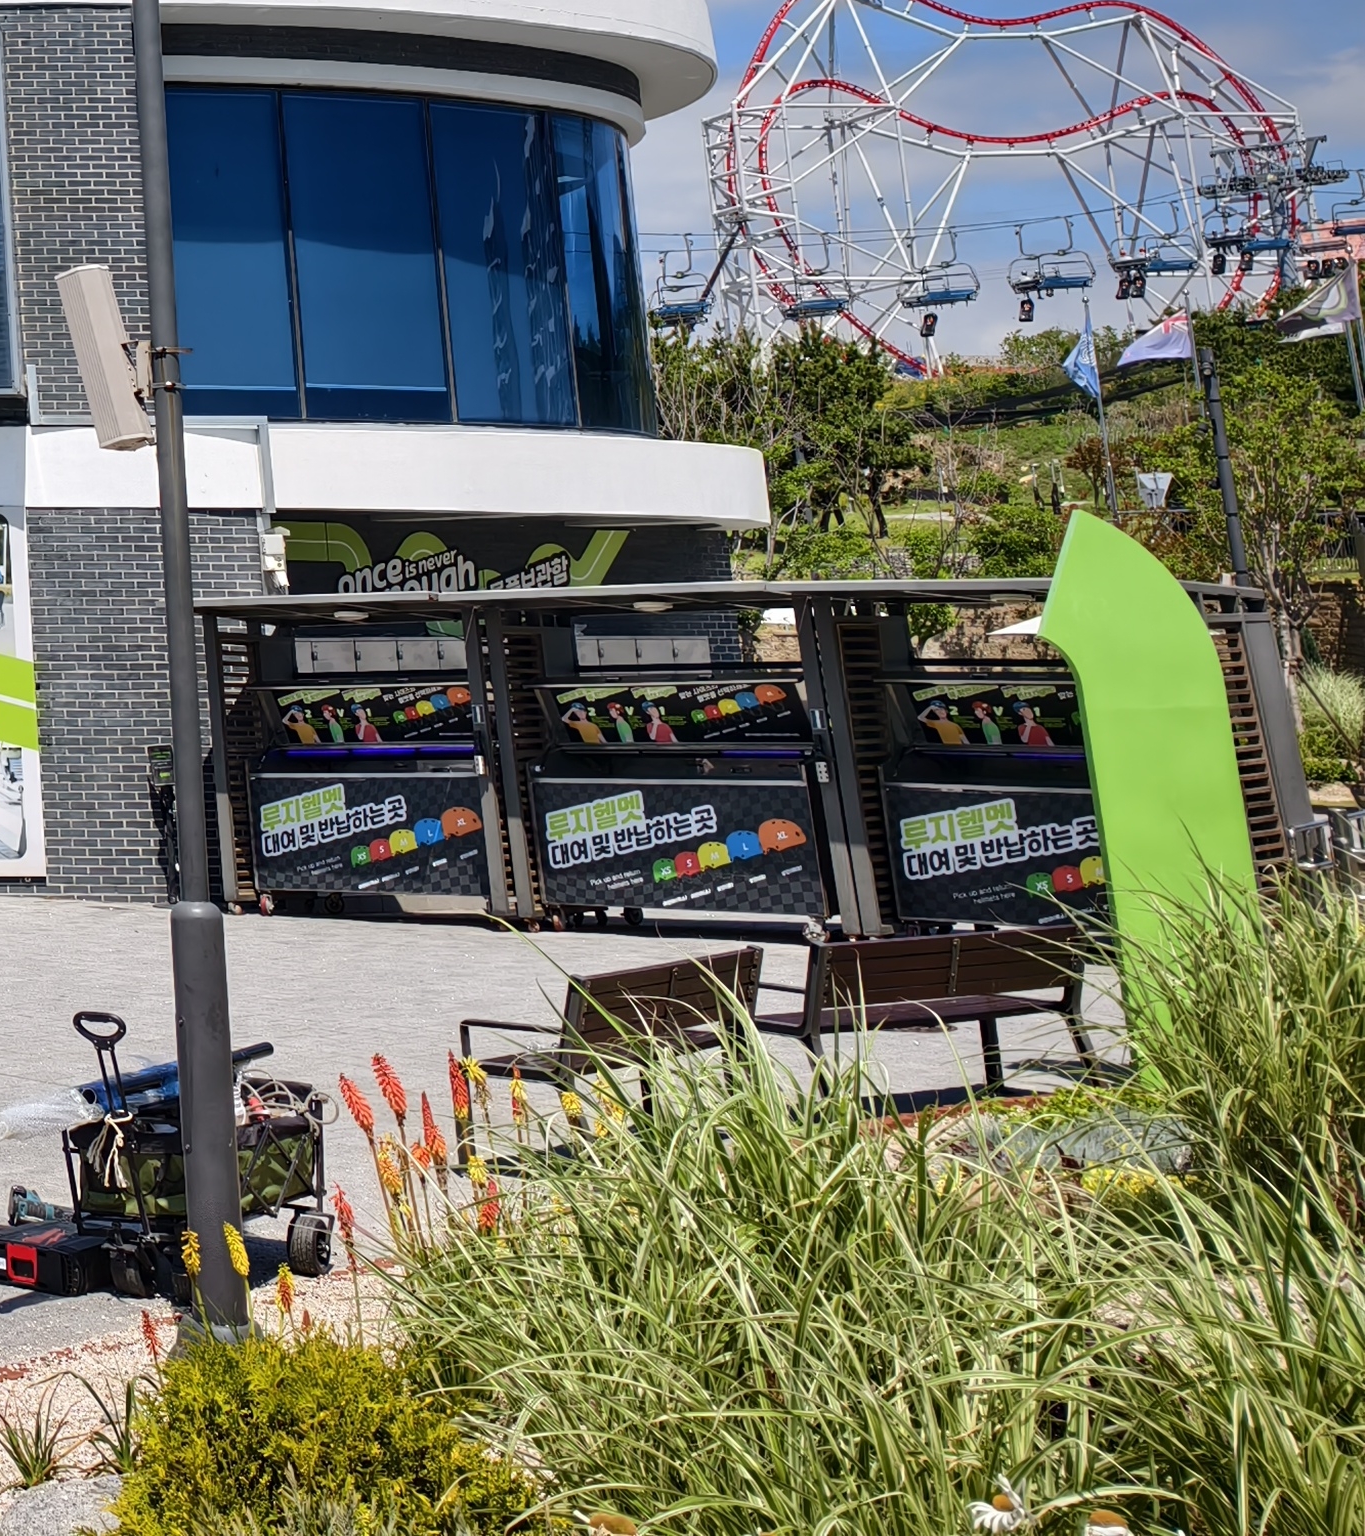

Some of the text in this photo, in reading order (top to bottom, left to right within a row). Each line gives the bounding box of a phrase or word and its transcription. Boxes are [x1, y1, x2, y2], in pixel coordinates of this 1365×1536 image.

[338, 549, 458, 594] once is never
[262, 786, 343, 831] 루지헬멧
[548, 794, 642, 841] 루지헬멧
[264, 797, 405, 855] 대여 및 반납하는 곳
[903, 801, 1015, 850] 루지헬멧
[427, 829, 433, 838] L
[551, 807, 715, 867] 대여 및 반납하는 곳
[776, 830, 789, 841] XL
[379, 844, 385, 854] S
[742, 843, 750, 852] L
[906, 848, 950, 877] 대여
[954, 843, 977, 869] 및
[980, 826, 1072, 862] 반납하는
[357, 851, 368, 861] XS
[686, 859, 692, 868] S
[660, 866, 672, 876] XS
[1066, 874, 1073, 883] S
[1035, 880, 1049, 892] XS
